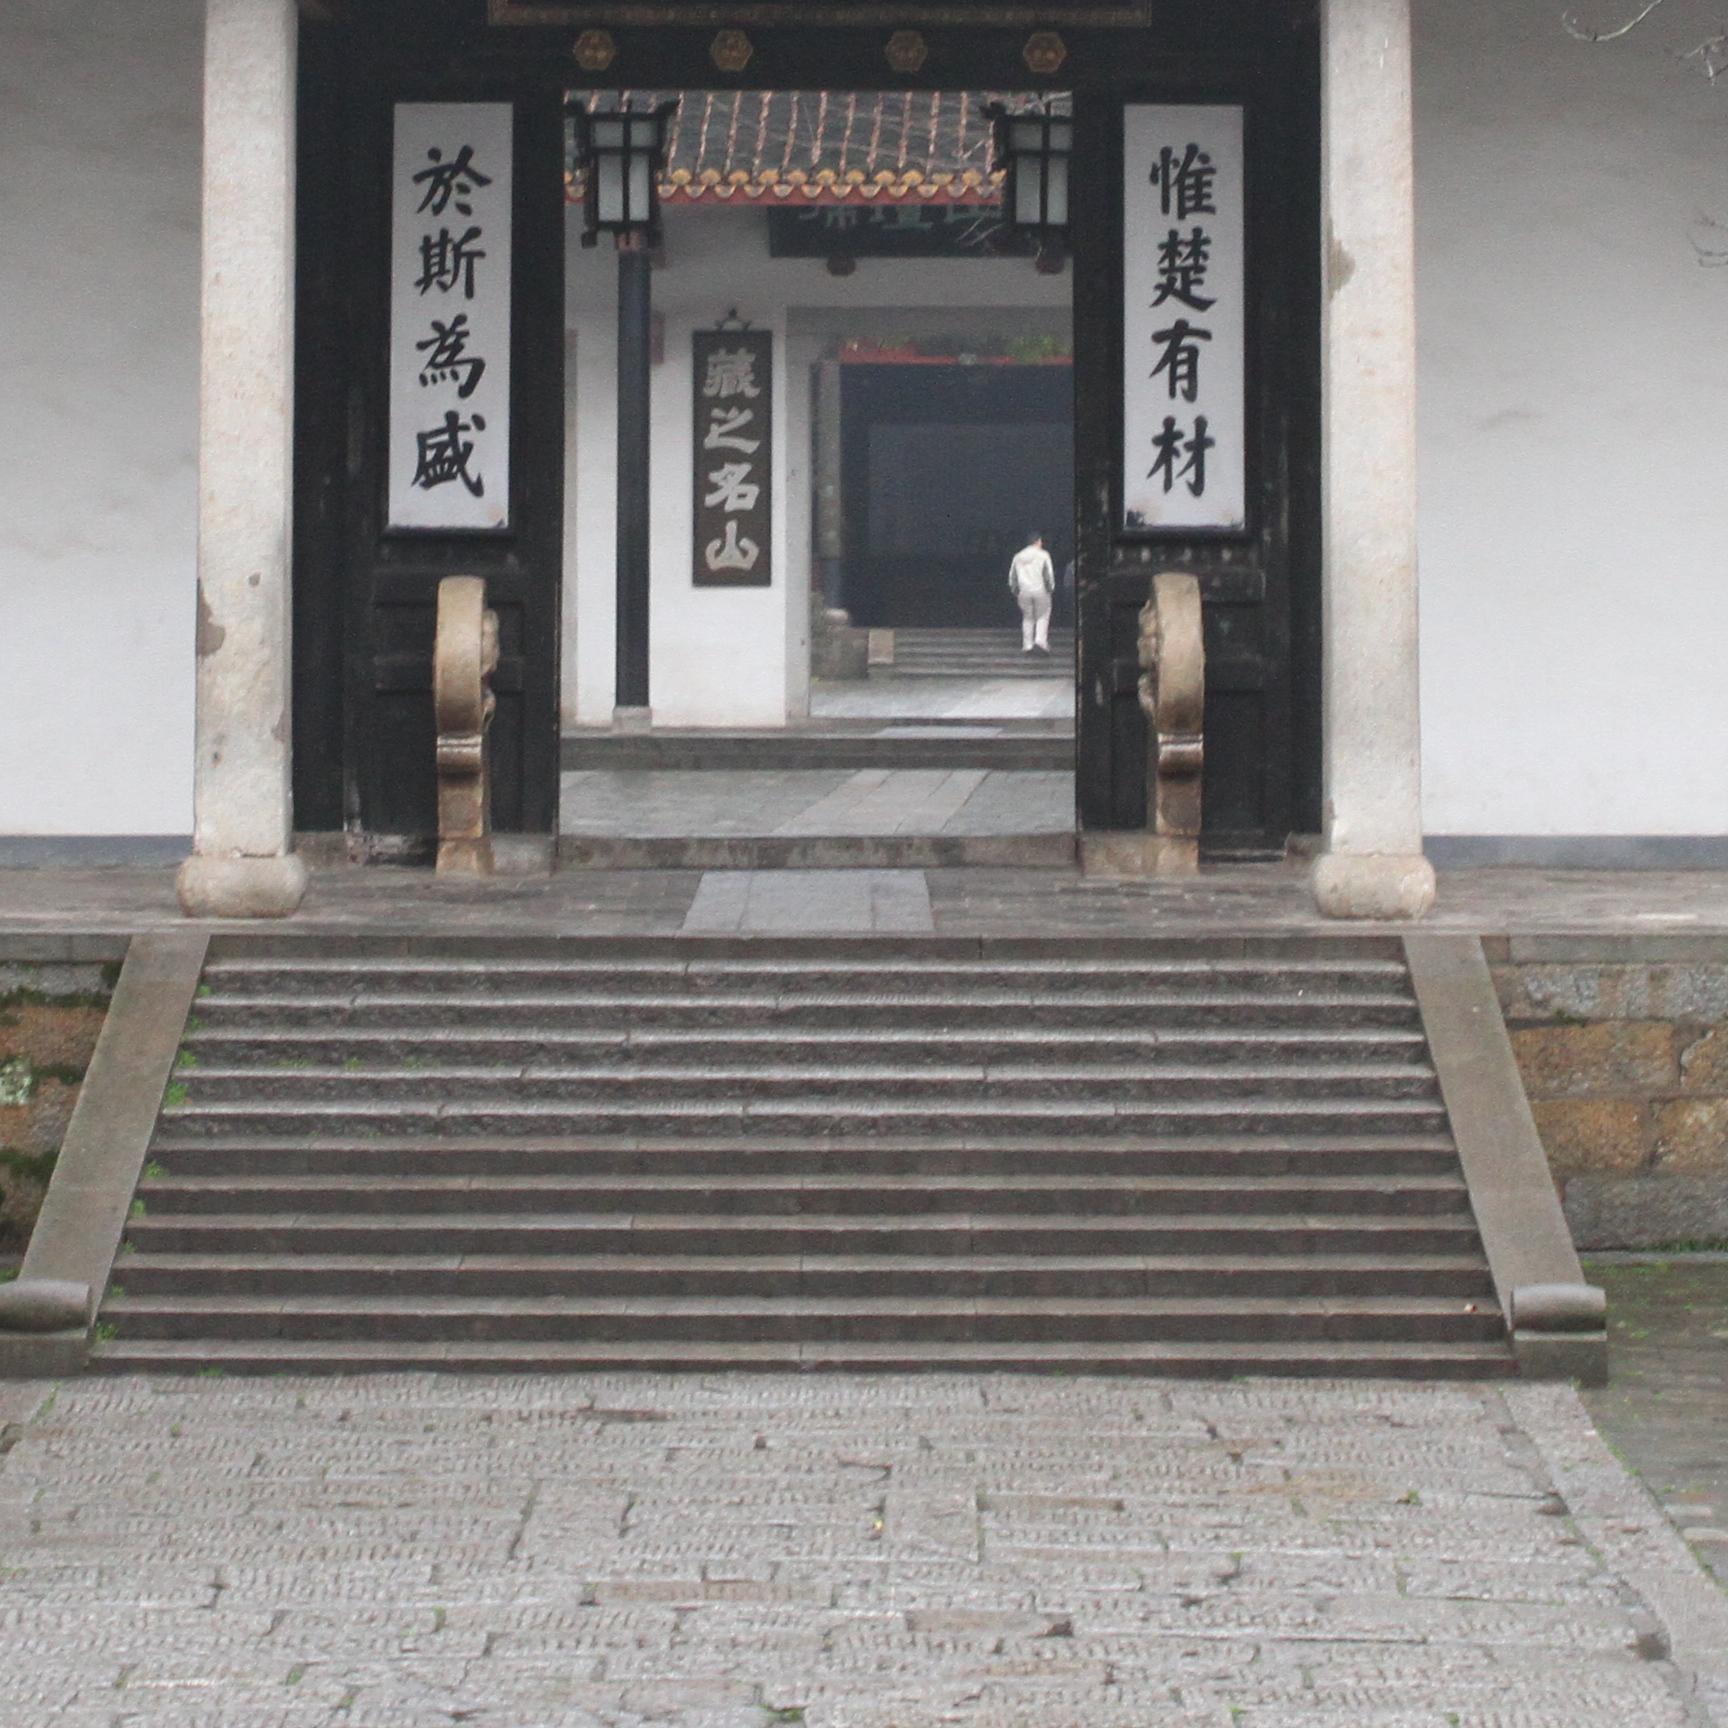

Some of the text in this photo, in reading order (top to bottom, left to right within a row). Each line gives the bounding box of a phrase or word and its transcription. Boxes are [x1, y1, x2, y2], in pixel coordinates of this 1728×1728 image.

[411, 145, 492, 498] 於斯為盛
[702, 347, 761, 571] 藏之名山
[1147, 142, 1217, 498] 惟楚有材
